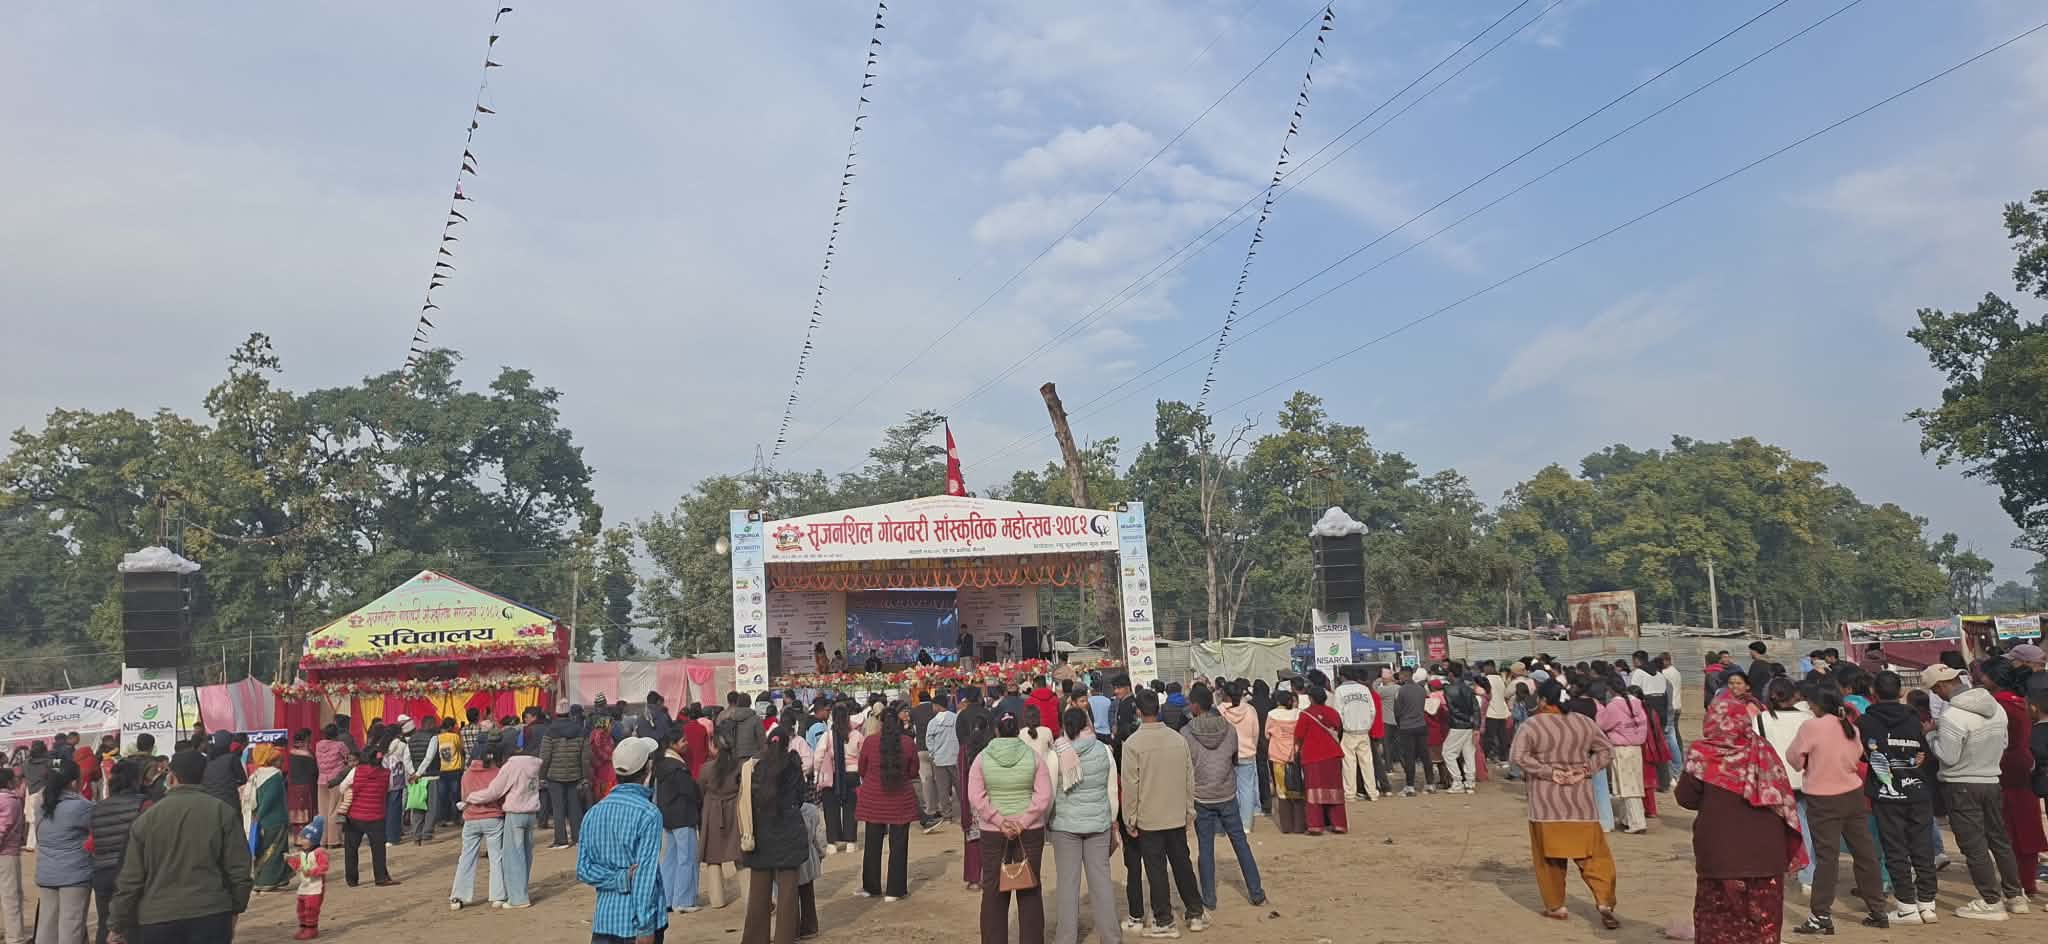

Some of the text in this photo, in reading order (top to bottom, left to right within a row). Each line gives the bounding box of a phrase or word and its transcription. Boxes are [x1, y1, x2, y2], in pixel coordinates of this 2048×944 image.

[878, 514, 929, 544] गोदावरी
[933, 511, 997, 547] सांस्कृतिक
[1315, 624, 1349, 633] NISARGA
[368, 628, 496, 648] सचिवालय
[1316, 656, 1351, 665] NISARGA
[123, 681, 174, 692] NISARGA
[122, 720, 173, 732] NISARGA
